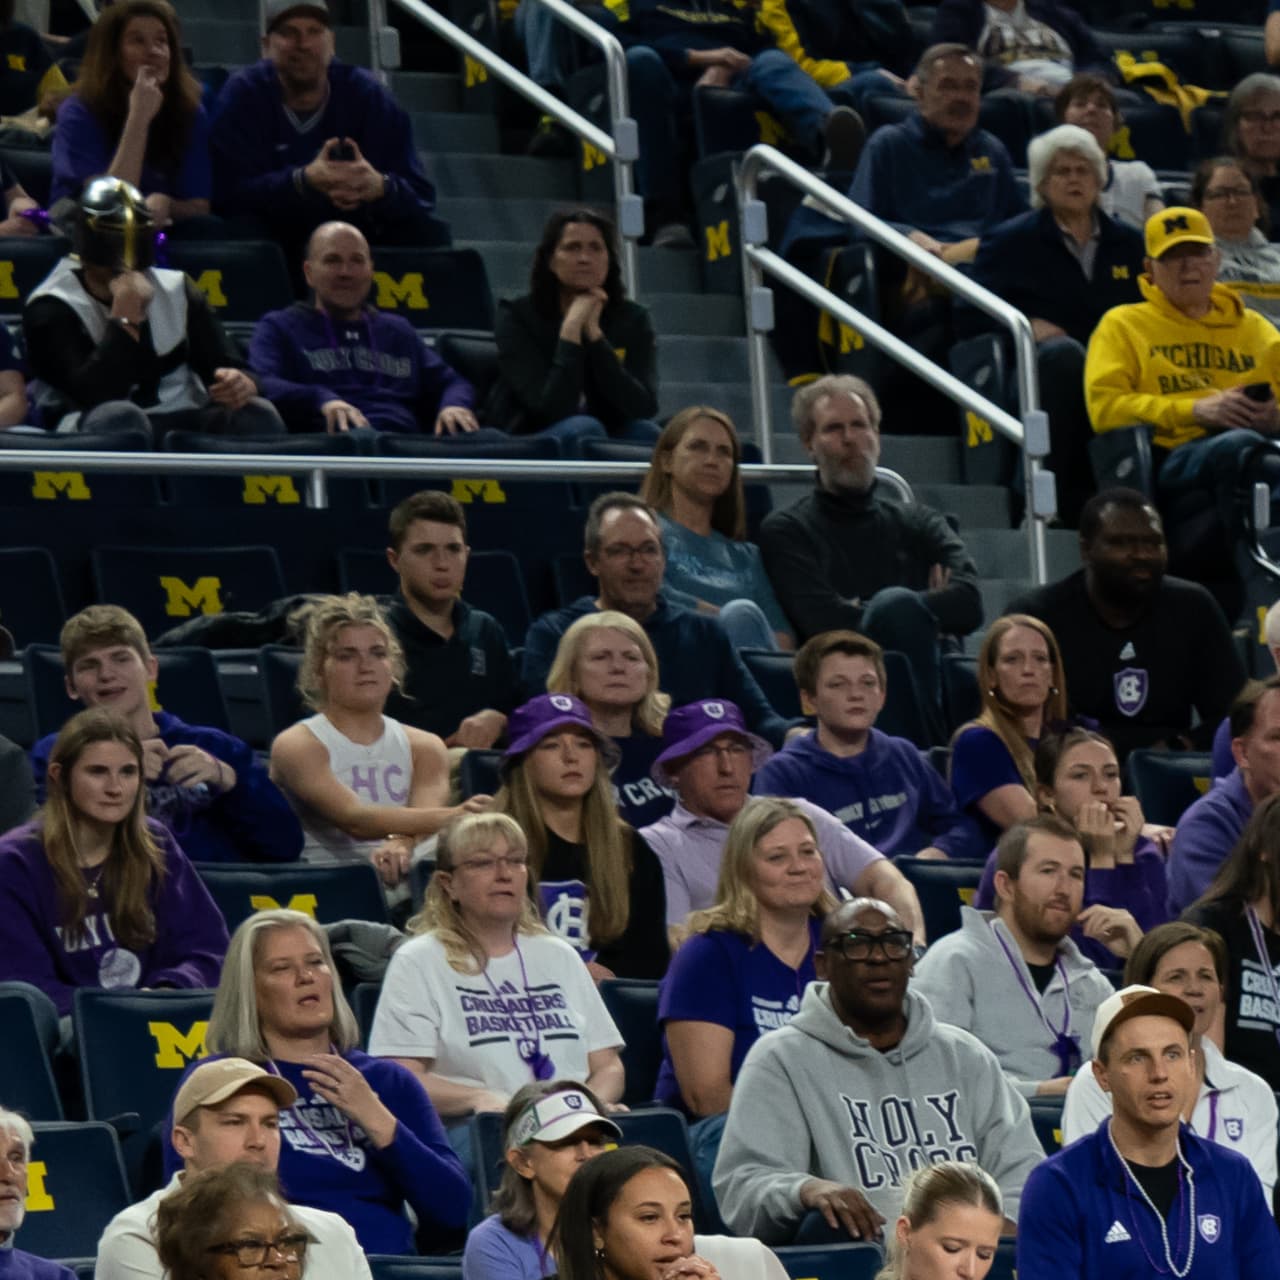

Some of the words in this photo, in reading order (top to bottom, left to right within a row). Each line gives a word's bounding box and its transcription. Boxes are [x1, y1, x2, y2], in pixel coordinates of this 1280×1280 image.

[706, 221, 731, 260] M
[1163, 215, 1190, 234] M
[371, 272, 428, 308] M
[966, 412, 993, 447] M
[33, 472, 90, 499] M
[244, 476, 299, 503] M
[451, 479, 505, 503] M
[160, 577, 223, 616] M
[148, 1021, 210, 1068] M
[841, 1091, 959, 1148] HOLY
